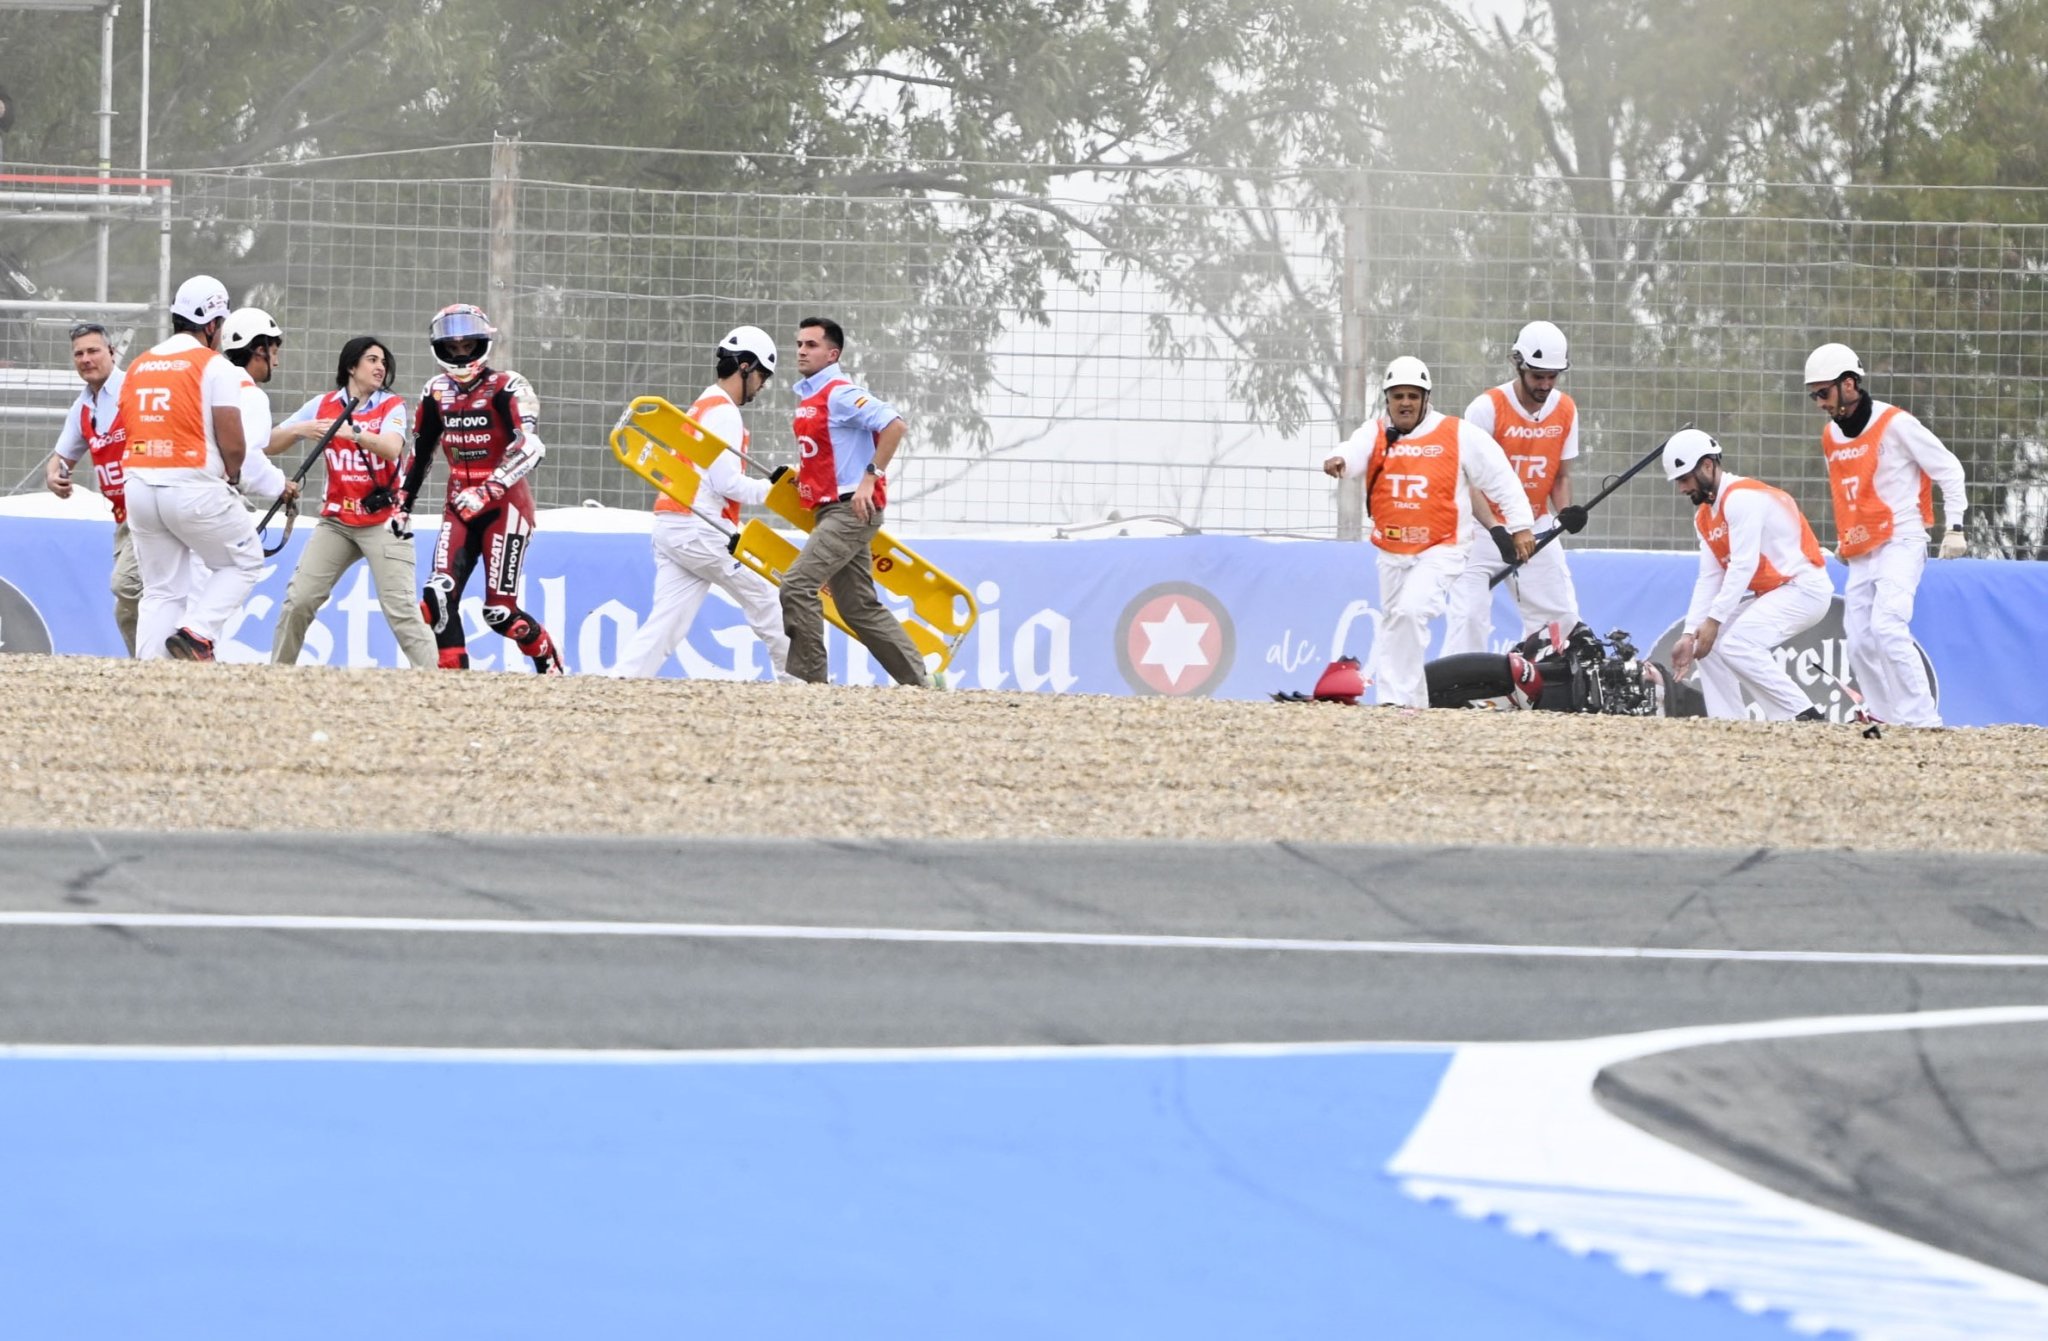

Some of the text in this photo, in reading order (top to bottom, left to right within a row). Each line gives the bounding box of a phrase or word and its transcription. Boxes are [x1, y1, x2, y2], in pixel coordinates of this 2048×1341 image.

[136, 387, 171, 411] TR
[1504, 425, 1563, 438] MotoGP
[1510, 454, 1548, 479] TR
[1385, 474, 1428, 499] TR
[1393, 501, 1421, 510] TRACK
[435, 521, 452, 569] DUCATI
[488, 533, 504, 589] DUCATI
[504, 539, 521, 588] Lenovo
